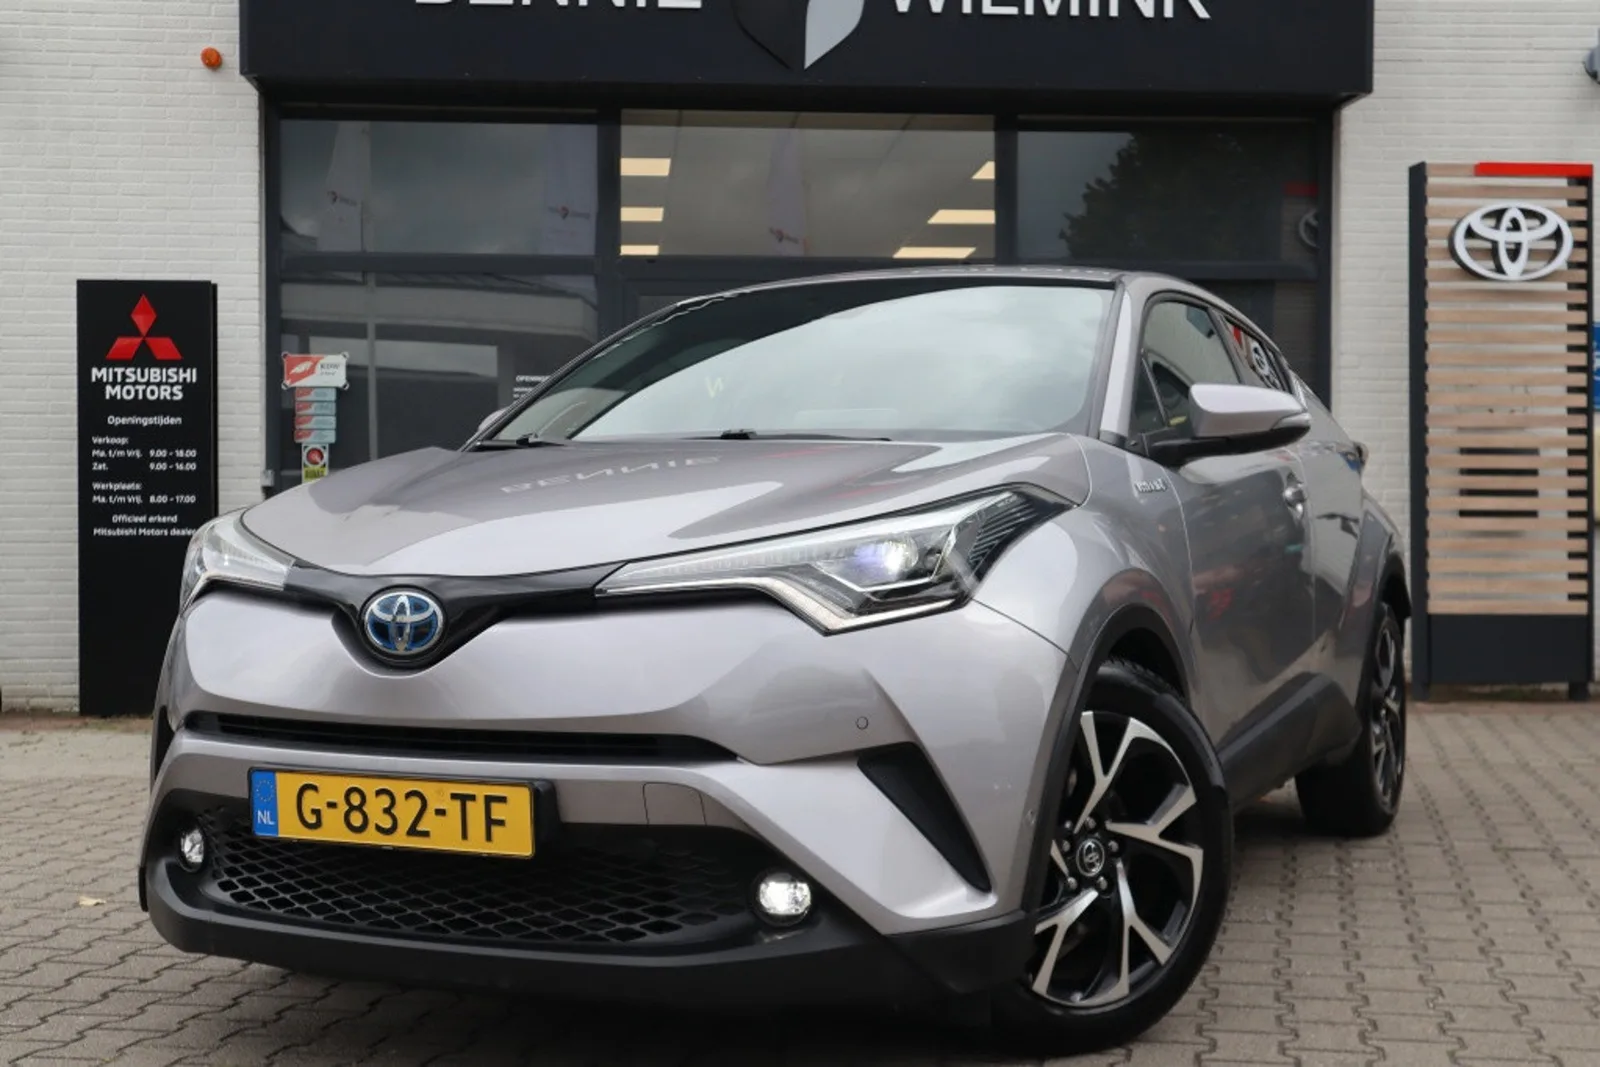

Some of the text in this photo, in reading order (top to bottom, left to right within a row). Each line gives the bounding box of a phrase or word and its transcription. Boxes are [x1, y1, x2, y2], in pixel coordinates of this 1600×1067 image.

[91, 367, 197, 383] MITSUBISHI
[105, 384, 183, 400] MOTORS
[107, 415, 182, 426] Openingstijden
[92, 436, 129, 445] Verkoop:
[92, 462, 108, 471] Zat.
[148, 514, 178, 523] erkend
[93, 527, 137, 536] Mitsubishi
[138, 527, 168, 536] Motors
[257, 809, 275, 826] NL
[295, 782, 508, 843] G-832-TF
